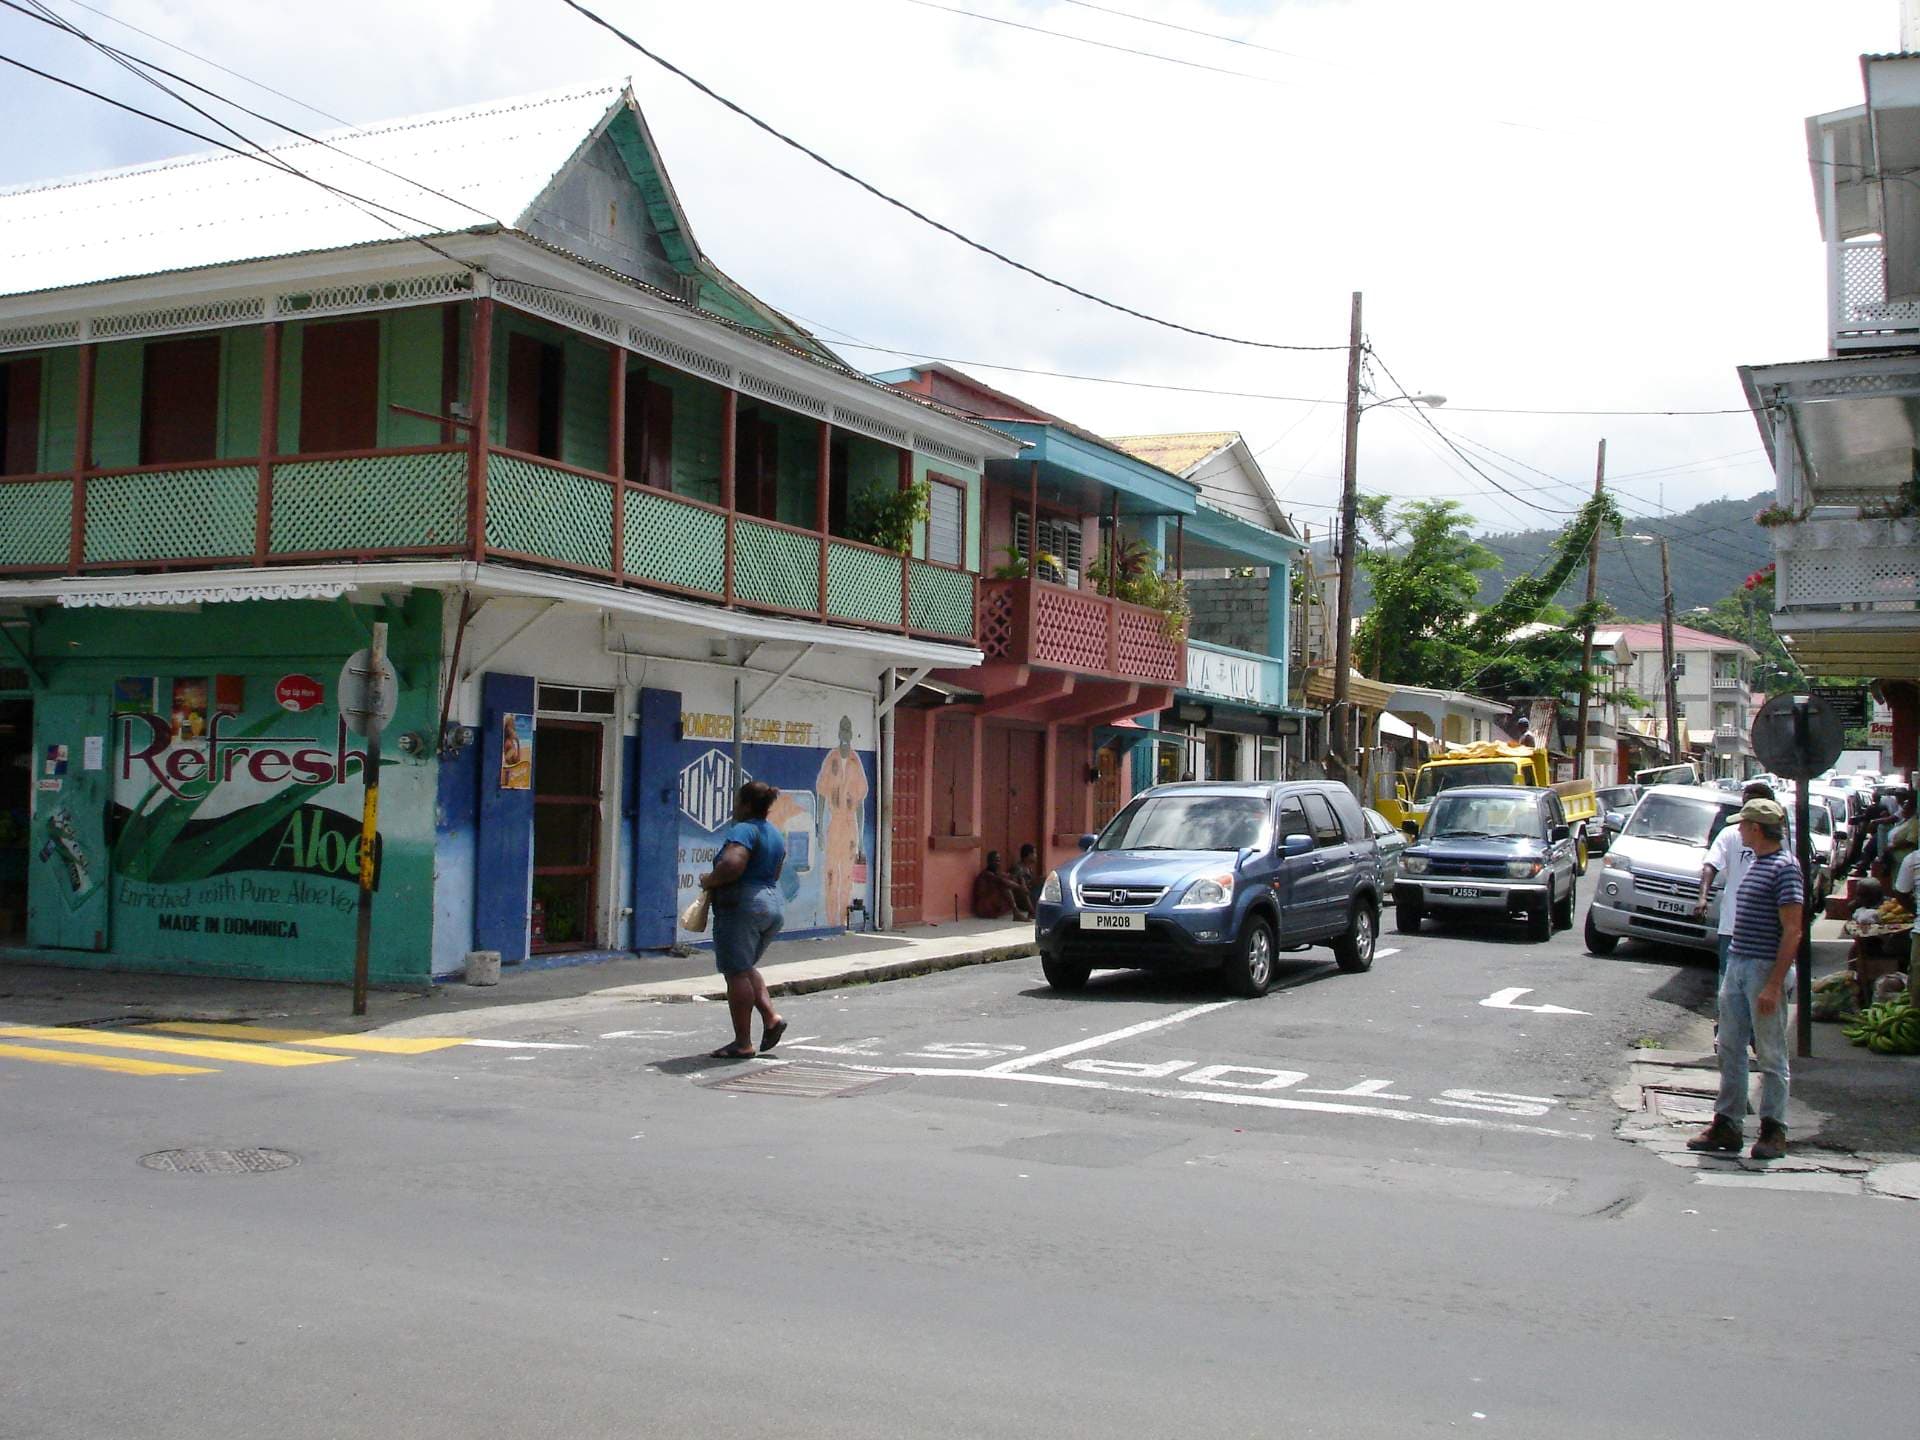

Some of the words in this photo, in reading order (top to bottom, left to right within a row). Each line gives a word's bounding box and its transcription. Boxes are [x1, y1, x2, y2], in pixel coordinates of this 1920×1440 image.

[110, 711, 368, 799] Refresh
[330, 885, 359, 914] Ver
[1657, 900, 1685, 912] TF194
[158, 913, 200, 933] MADE
[204, 916, 219, 934] IN
[224, 917, 299, 939] DOMINICA
[1096, 915, 1130, 928] PM208
[1063, 1058, 1559, 1116] STOP
